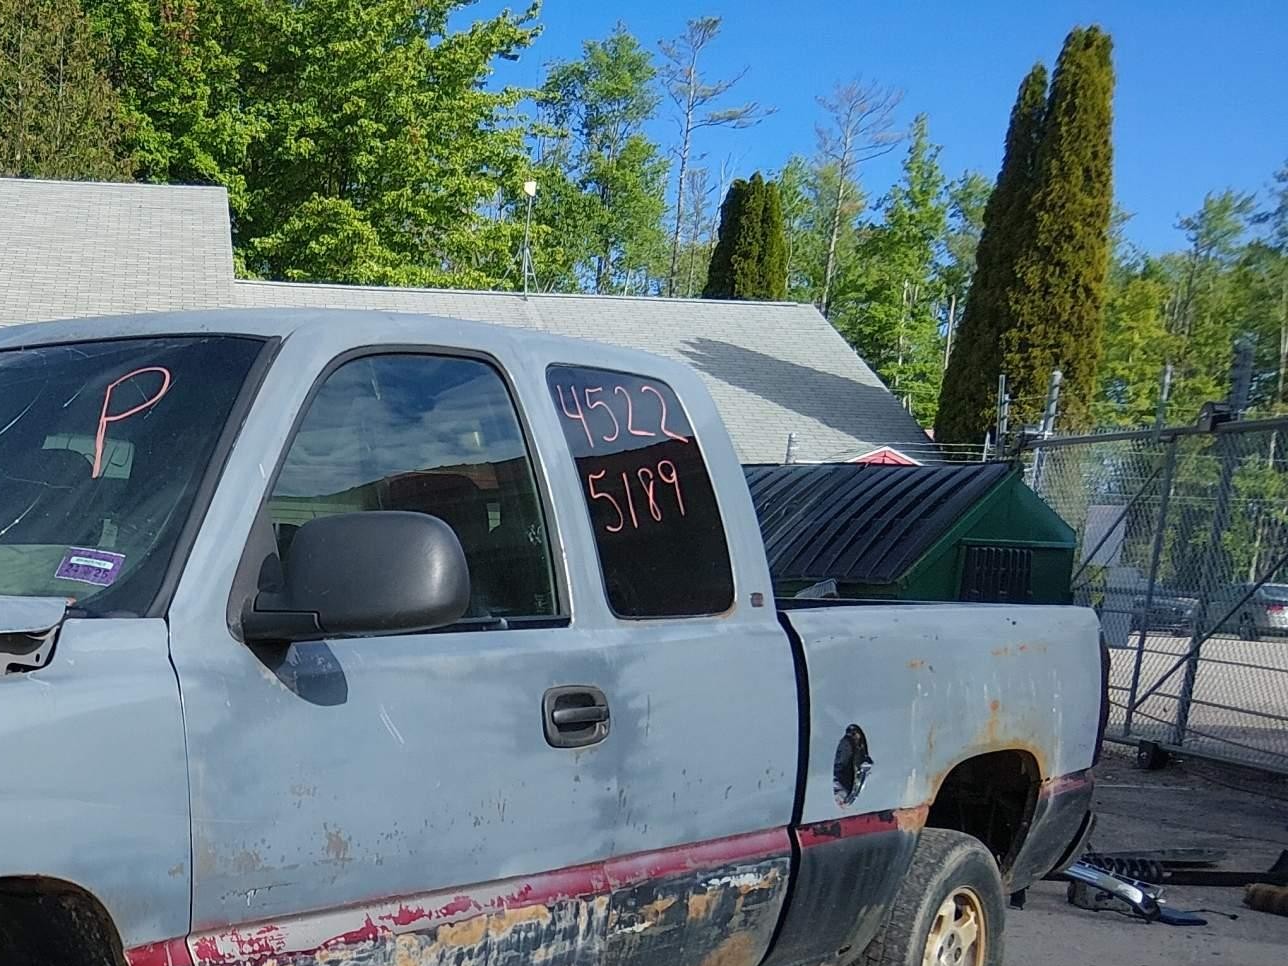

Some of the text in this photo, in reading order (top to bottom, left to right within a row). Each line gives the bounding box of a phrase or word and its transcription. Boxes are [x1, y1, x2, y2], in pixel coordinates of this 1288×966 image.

[92, 366, 171, 479] P
[556, 384, 689, 449] 4522
[588, 460, 686, 532] 5189
